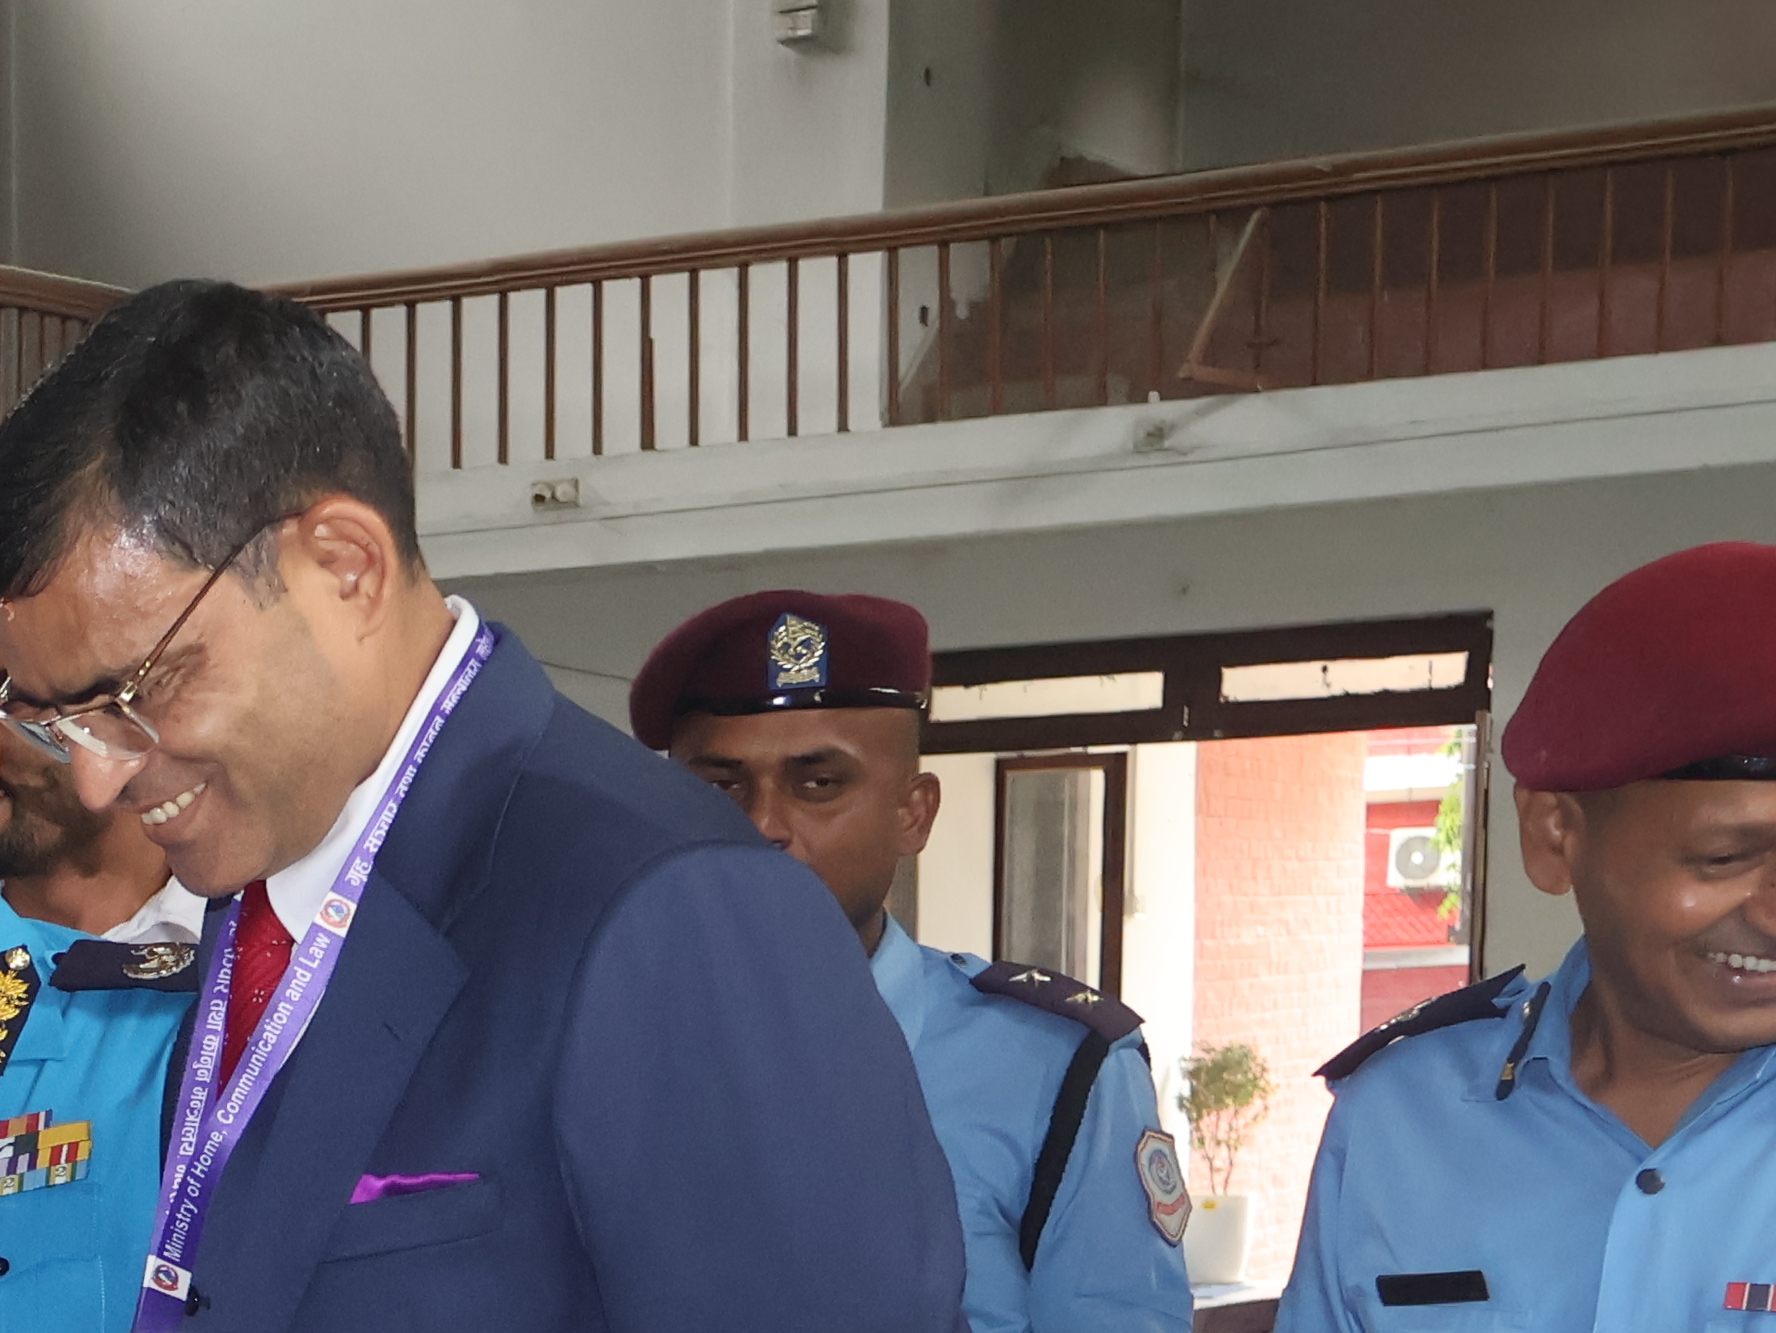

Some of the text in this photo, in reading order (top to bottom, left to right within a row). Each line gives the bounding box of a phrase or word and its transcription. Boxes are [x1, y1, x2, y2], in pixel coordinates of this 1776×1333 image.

[308, 933, 330, 967] Law
[286, 965, 310, 1002] and
[217, 1003, 289, 1124] Communication
[191, 1127, 228, 1178] Home,
[187, 1175, 203, 1199] of
[164, 1200, 200, 1263] Ministry
